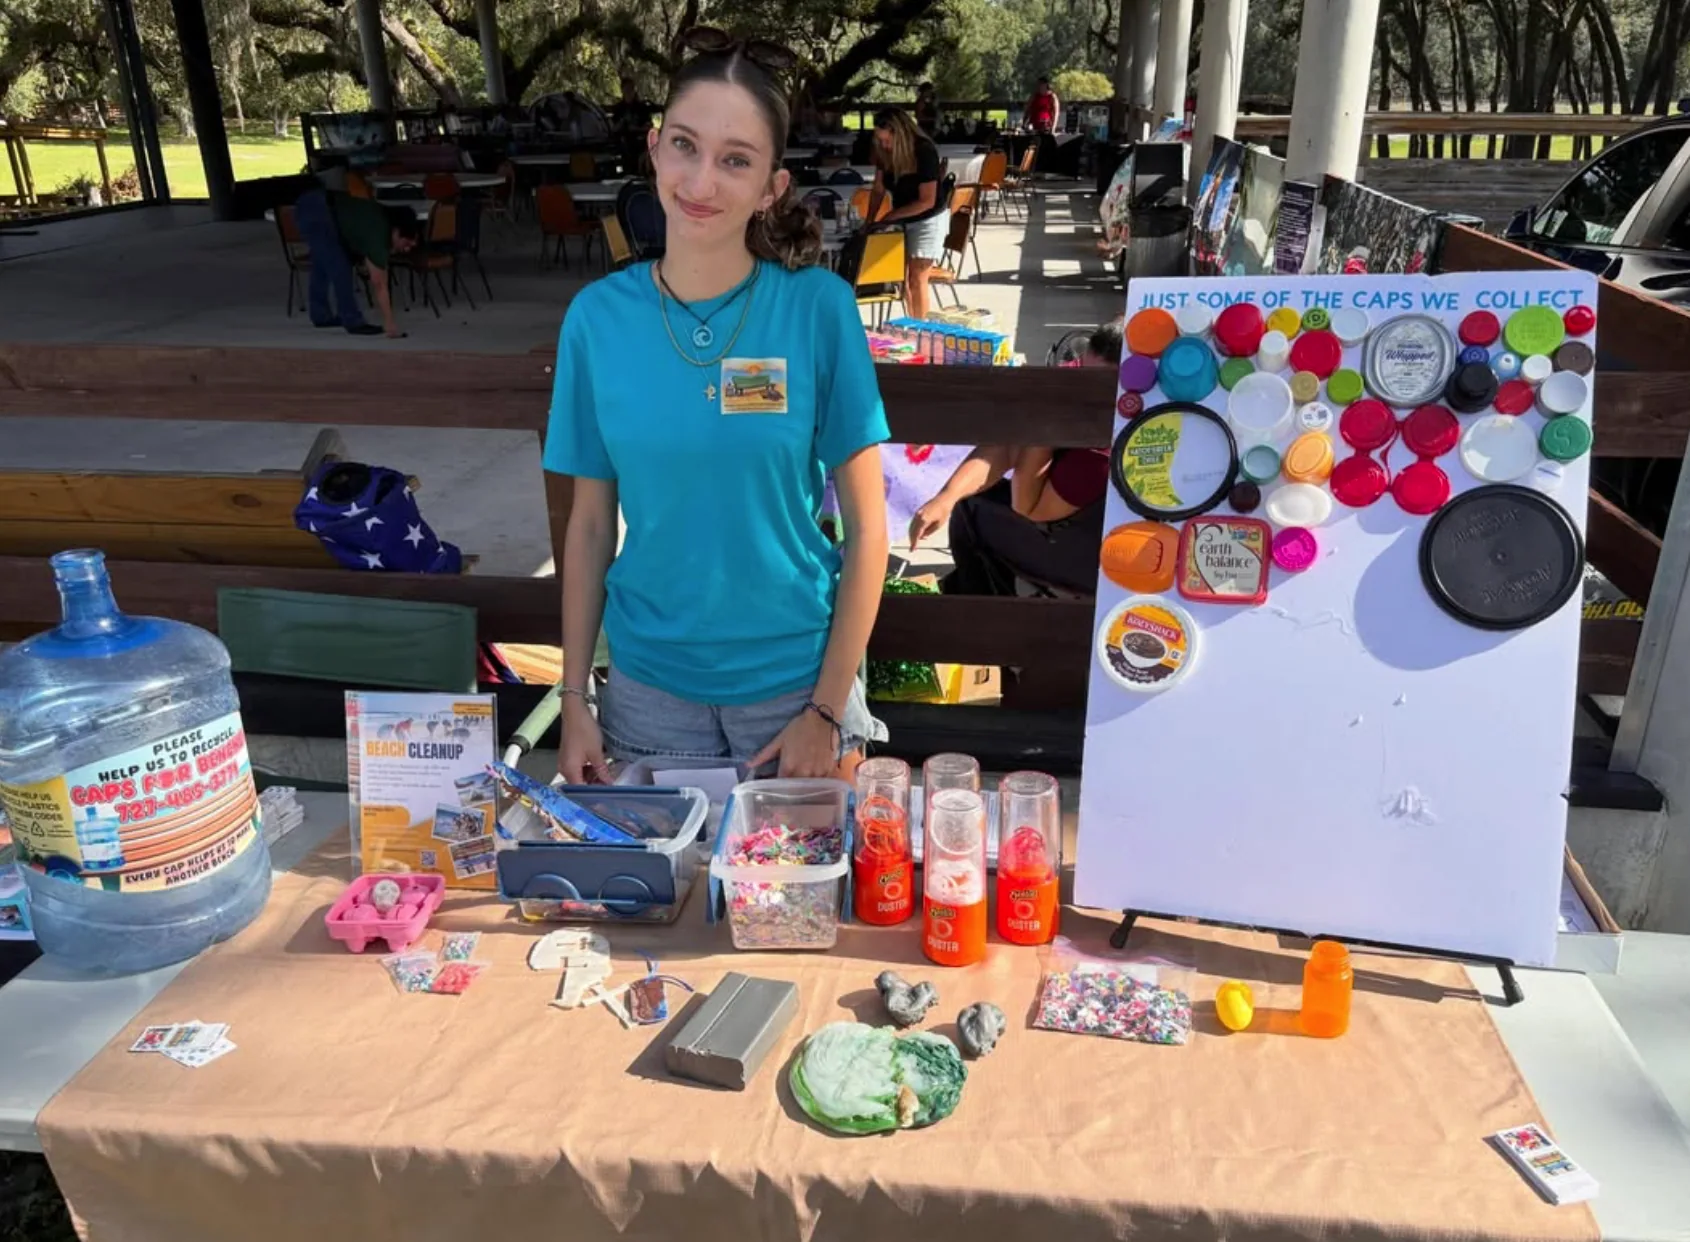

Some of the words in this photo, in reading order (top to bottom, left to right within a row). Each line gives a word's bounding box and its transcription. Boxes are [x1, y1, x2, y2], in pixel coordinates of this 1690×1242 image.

[1139, 292, 1189, 310] JUST
[1195, 291, 1256, 308] SOME
[1262, 290, 1291, 308] OF
[1301, 290, 1343, 308] THE
[1352, 290, 1413, 310] CAPS
[1421, 291, 1460, 310] WE
[1475, 290, 1584, 310] COLLECT
[1199, 543, 1232, 555] earth
[1205, 555, 1249, 568] balance
[153, 729, 203, 756] PLEASE
[366, 740, 406, 757] BEACH
[408, 742, 464, 760] CLEANUP
[98, 765, 140, 782] HELP
[146, 758, 165, 772] US
[170, 750, 187, 765] TO
[193, 727, 235, 756] RECYCLE
[71, 779, 136, 806] CAPS
[142, 762, 192, 793] FOR
[22, 800, 61, 811] PLASTICS
[125, 870, 160, 884] EVERY
[164, 861, 185, 875] CAP
[188, 849, 215, 867] HELPS
[165, 861, 210, 885] ANOTHER
[212, 848, 237, 868] BENCH
